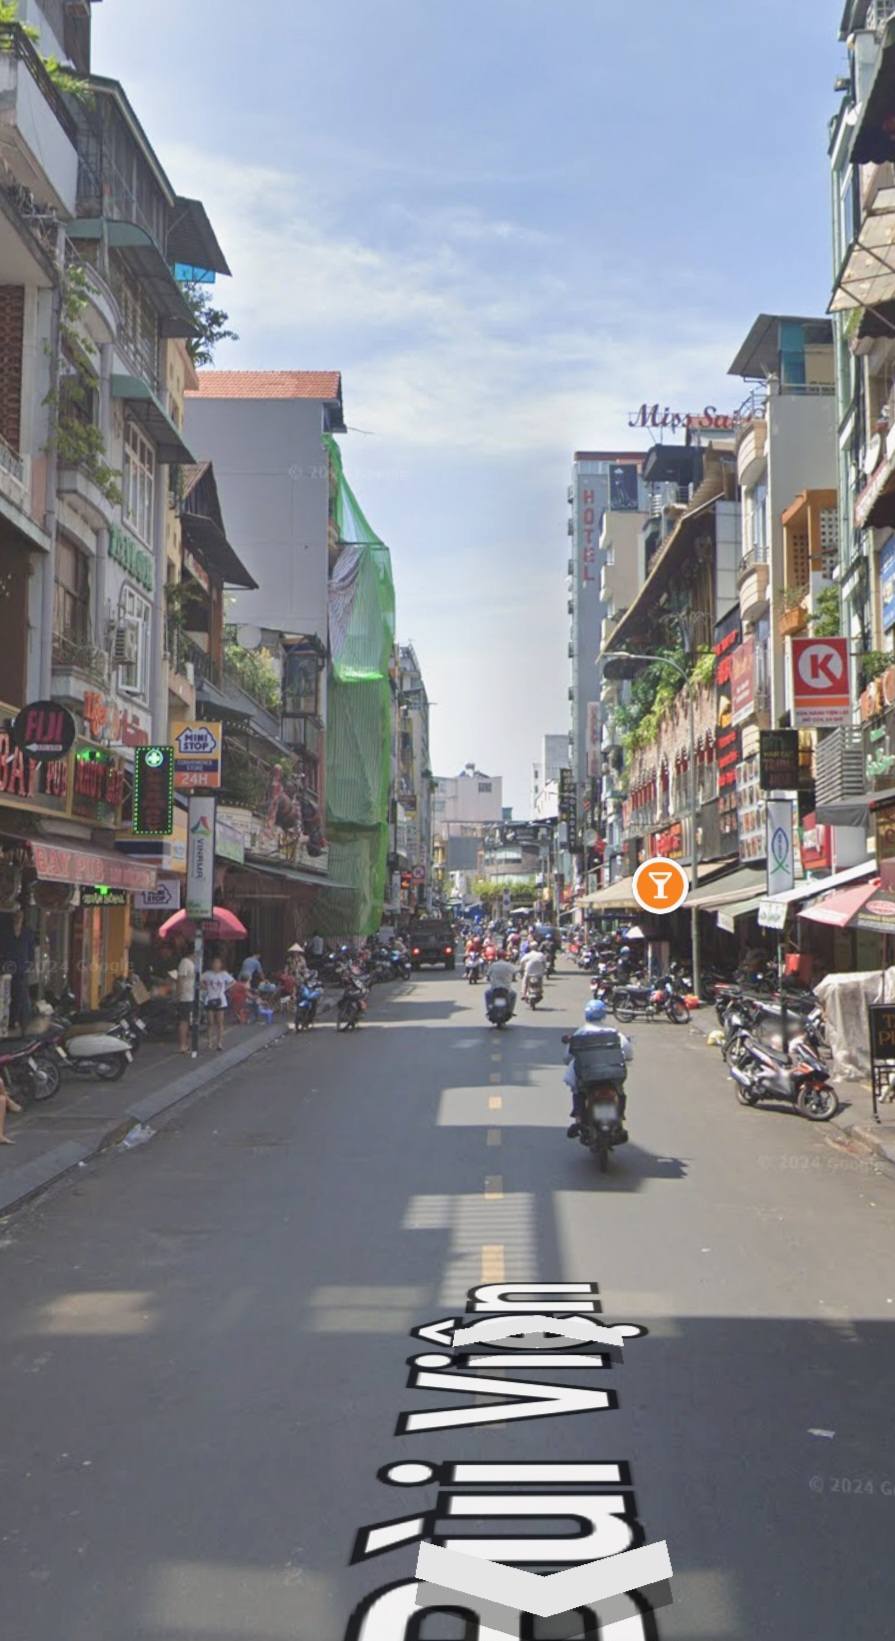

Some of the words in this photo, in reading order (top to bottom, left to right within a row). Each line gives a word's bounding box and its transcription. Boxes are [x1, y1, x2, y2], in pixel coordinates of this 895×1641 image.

[583, 489, 595, 581] HOTEL
[184, 734, 208, 742] MINI
[183, 742, 209, 751] STOP
[181, 772, 208, 785] 24H
